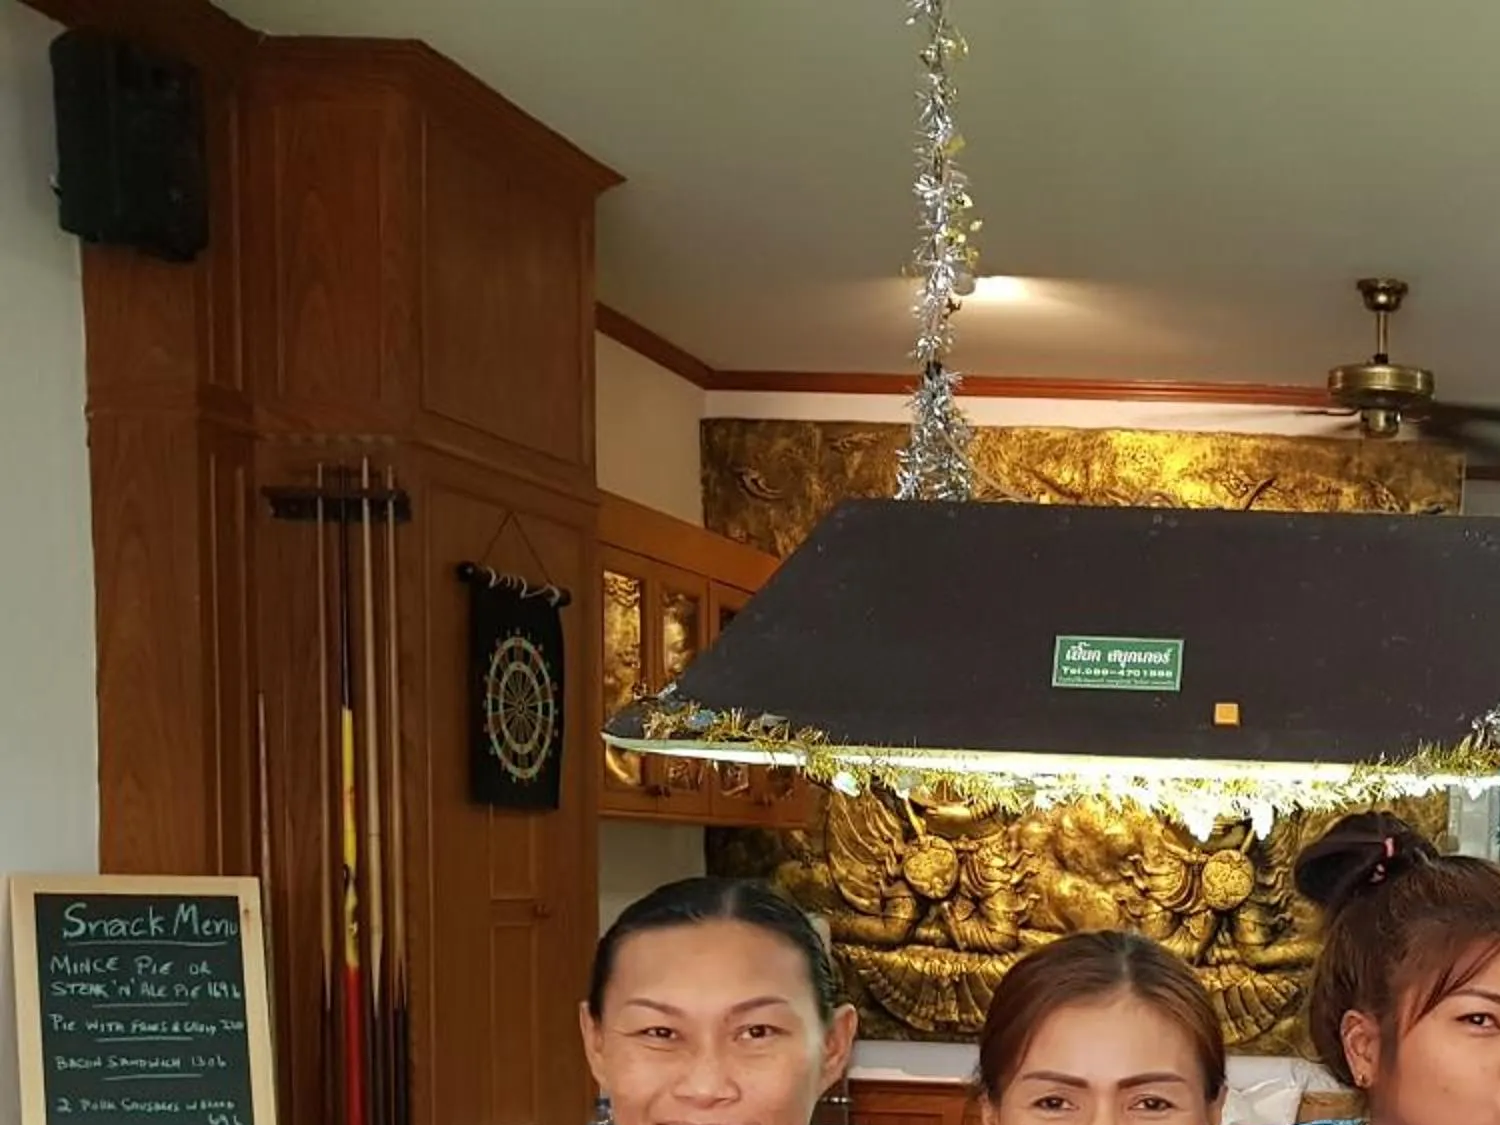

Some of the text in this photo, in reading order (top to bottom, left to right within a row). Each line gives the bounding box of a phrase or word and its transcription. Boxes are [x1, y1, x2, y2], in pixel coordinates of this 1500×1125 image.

[63, 902, 237, 938] Snack Menu
[57, 1097, 72, 1112] 2
